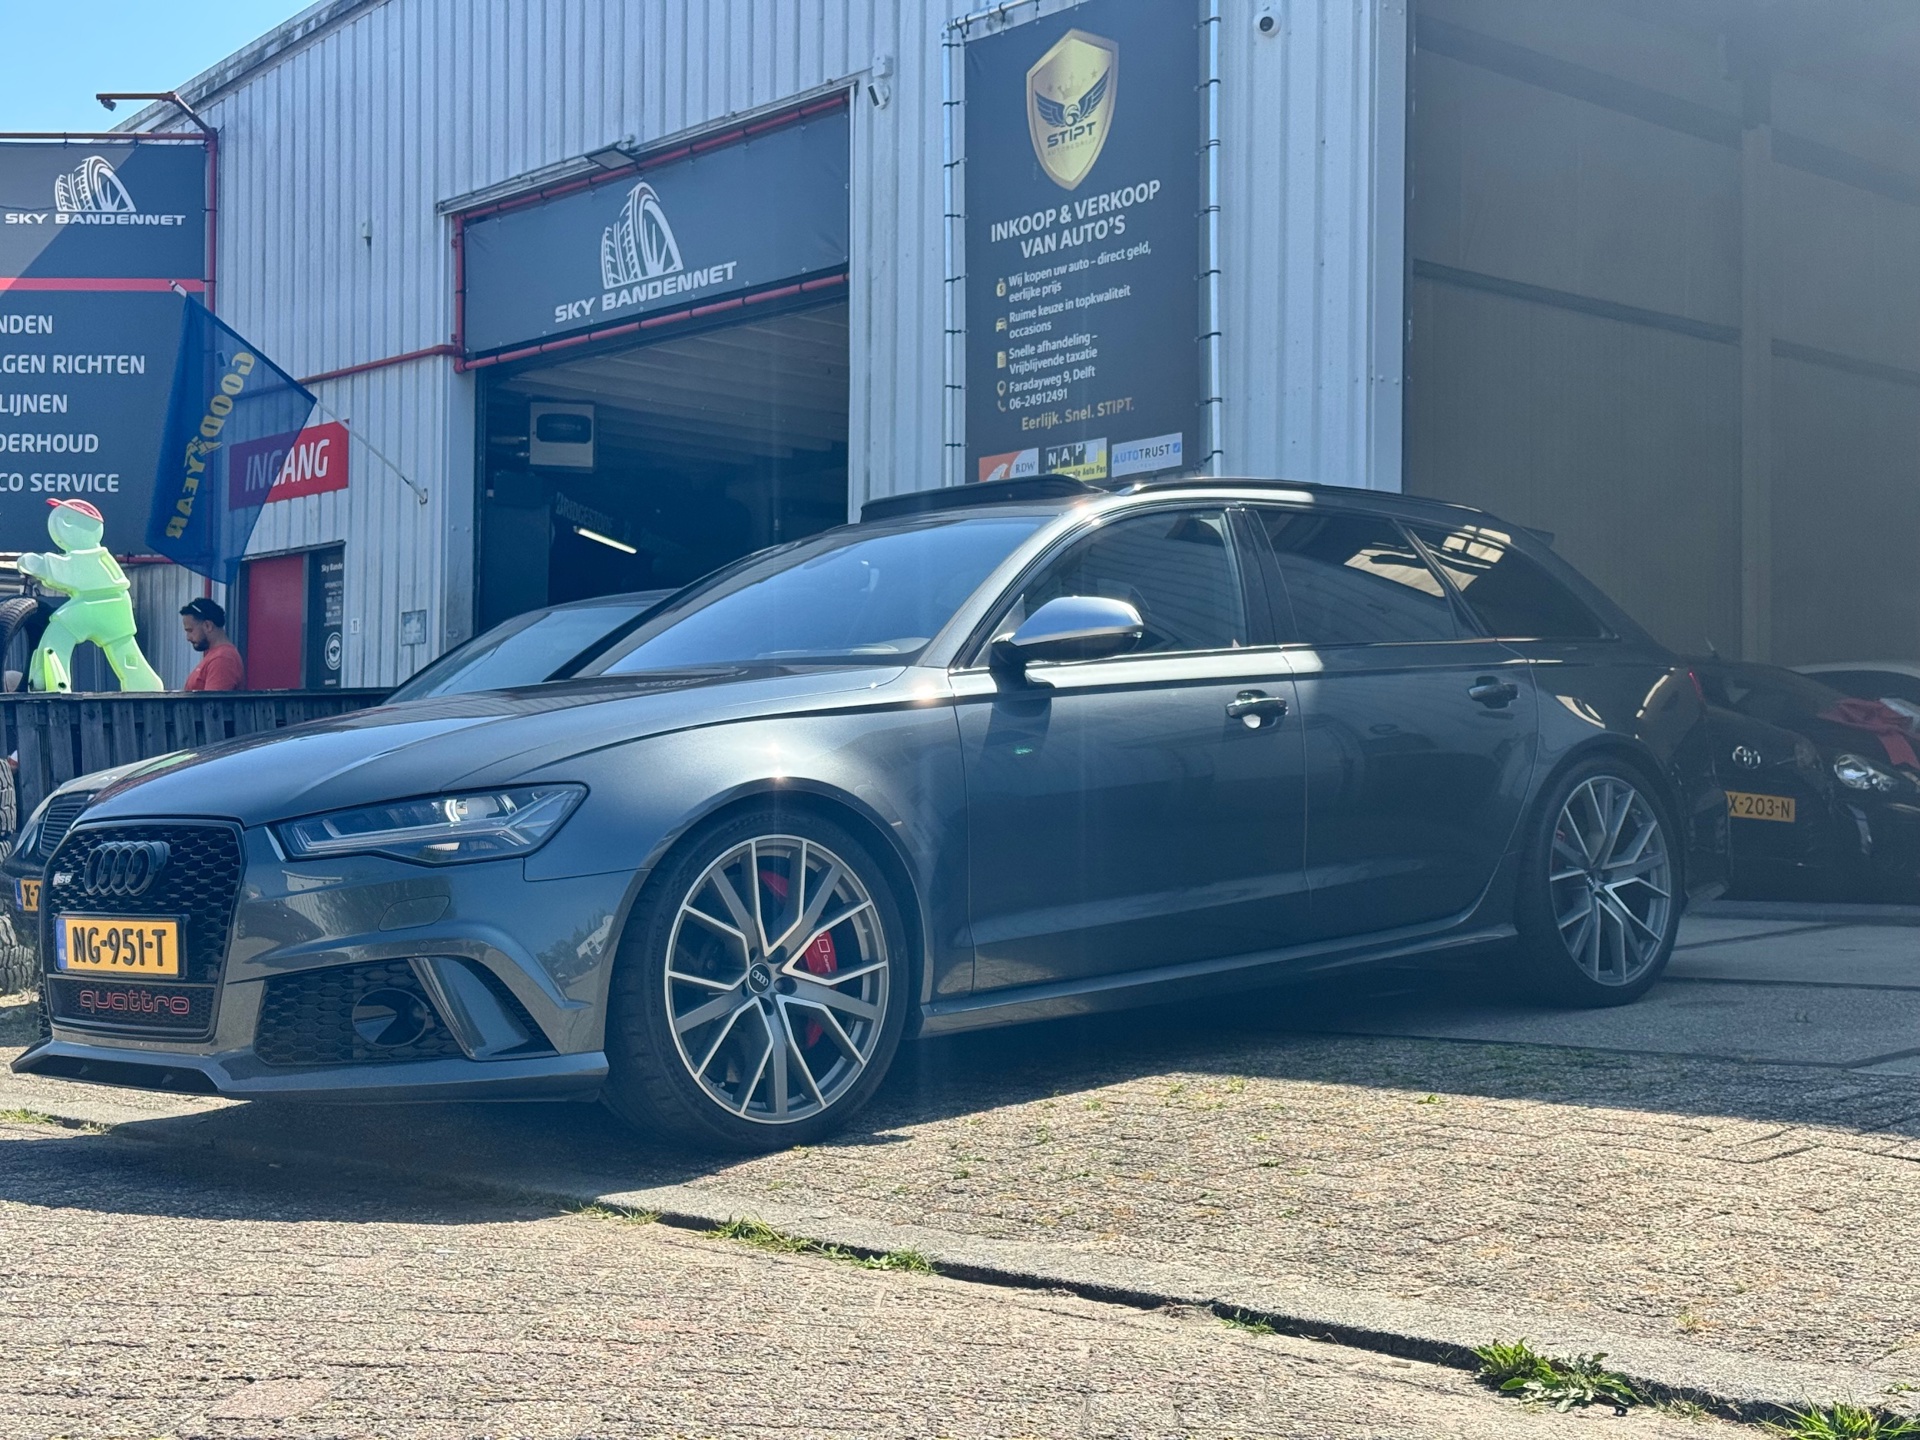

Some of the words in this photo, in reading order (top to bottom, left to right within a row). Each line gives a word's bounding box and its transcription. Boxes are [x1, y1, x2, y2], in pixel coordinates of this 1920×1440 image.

[1047, 121, 1096, 148] STIPT
[5, 213, 48, 225] SKY
[55, 213, 187, 226] BANDENNET
[991, 208, 1057, 243] INKOOP
[1059, 204, 1072, 224] &
[1074, 179, 1161, 220] VERKOOP
[1020, 234, 1057, 259] VAN
[1060, 214, 1126, 250] AUTO'S
[1008, 272, 1023, 288] Wij
[1024, 268, 1052, 285] kopen
[1053, 265, 1067, 276] uw
[1068, 258, 1089, 272] auto
[1097, 248, 1126, 265] direct
[1127, 241, 1152, 261] geld,
[555, 297, 596, 323] SKY
[602, 261, 737, 312] BANDENNET
[1009, 286, 1041, 303] eerlijke
[1042, 280, 1062, 298] prijs
[1009, 309, 1037, 323] Ruime
[1038, 301, 1064, 317] keuze
[1065, 299, 1074, 310] in
[1075, 285, 1131, 309] topkwaliteit
[0, 315, 53, 334] NDEN
[1009, 320, 1052, 339] occasions
[1009, 345, 1036, 360] Snelle
[1037, 333, 1091, 354] afhandeling
[0, 354, 46, 374] GEN
[52, 355, 146, 374] RICHTEN
[1009, 354, 1065, 375] Vrijblijvende
[1066, 347, 1098, 363] taxatie
[1009, 375, 1062, 393] Faradayweg
[1063, 371, 1072, 384] 9,
[1073, 366, 1096, 381] Delft
[0, 394, 68, 416] LIJNEN
[1009, 388, 1068, 410] 06-24912491
[1022, 411, 1063, 431] Eerlijk.
[1065, 404, 1095, 422] Snel.
[1097, 398, 1135, 417] STIPT.
[245, 438, 330, 493] INGANG
[1113, 443, 1171, 464] AUTOTRUST
[1015, 461, 1037, 474] RDW
[29, 473, 120, 493] SERVICE
[1728, 794, 1790, 819] X-203-N
[72, 926, 167, 967] NG-951-T
[80, 989, 190, 1015] quattro
